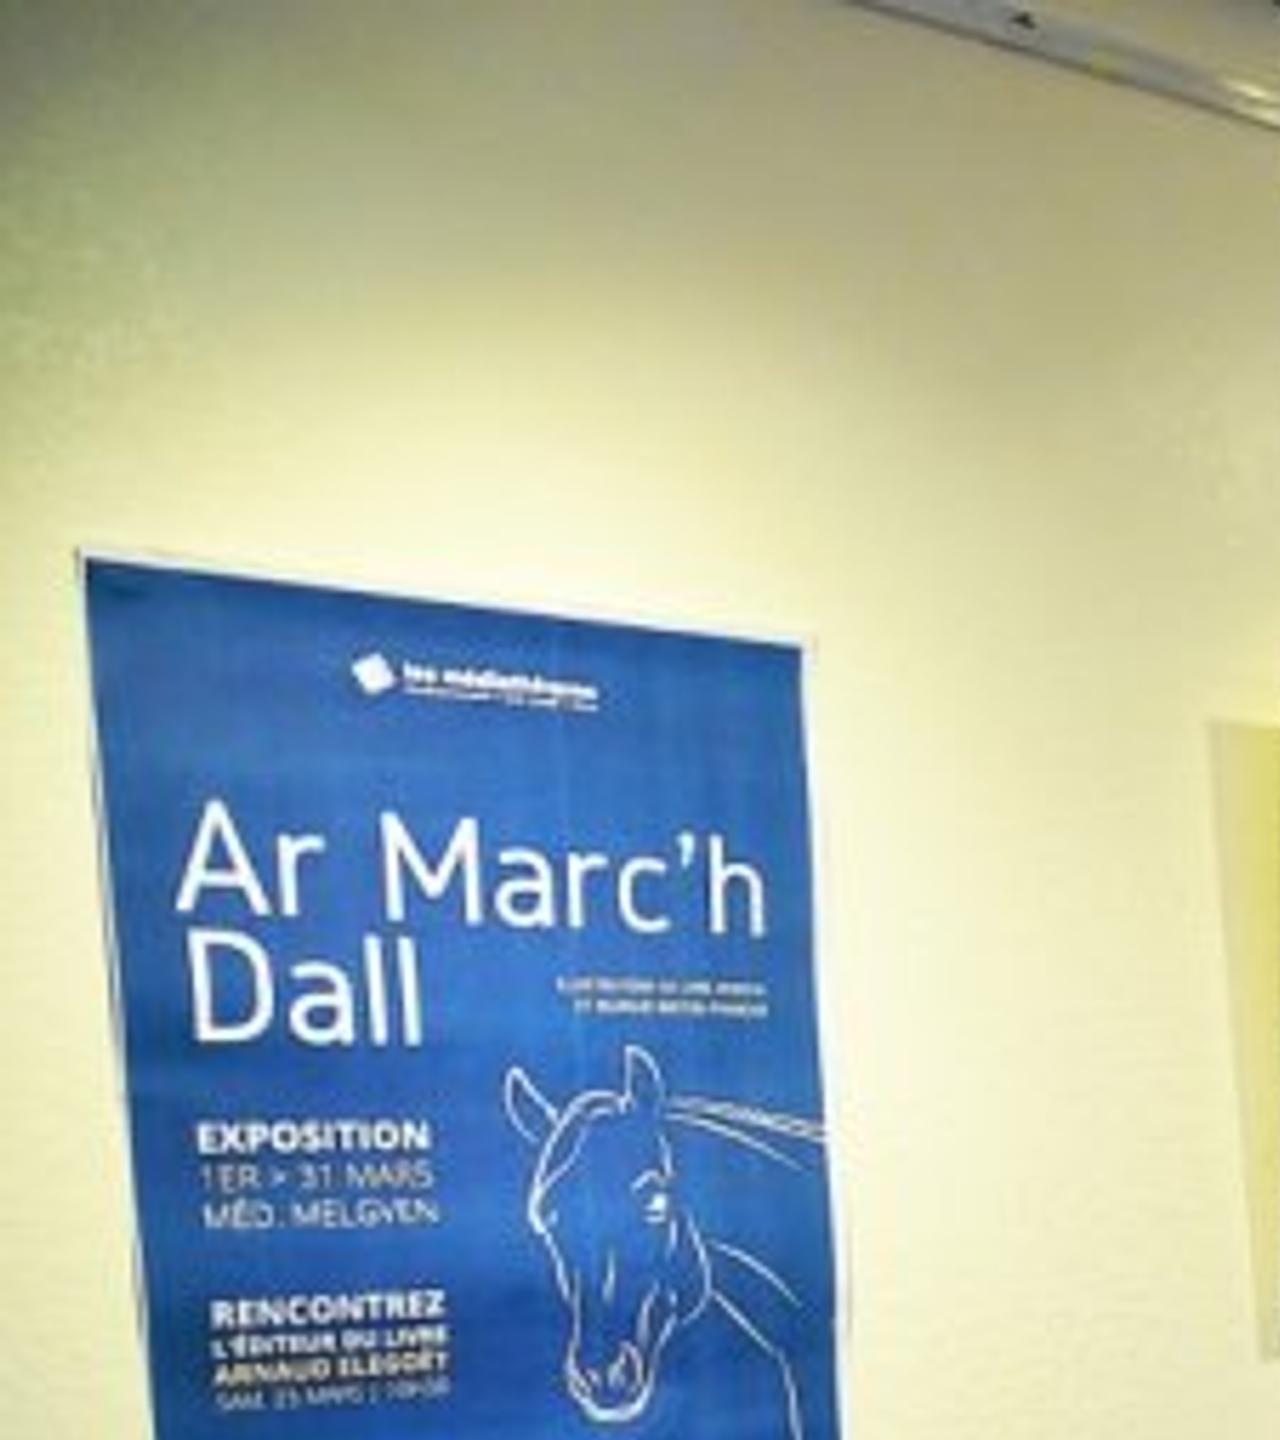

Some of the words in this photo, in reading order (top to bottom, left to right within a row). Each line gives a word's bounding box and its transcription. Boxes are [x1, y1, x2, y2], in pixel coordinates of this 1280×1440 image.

[175, 797, 326, 918] Ar
[379, 810, 767, 939] Marc'h
[186, 924, 422, 1047] Dall
[197, 1119, 432, 1154] EXPOSITION
[346, 1158, 434, 1188] MARS
[210, 1289, 446, 1329] RENCONTREZ
[341, 1327, 377, 1350] DU
[214, 1357, 331, 1385] ARNAUD
